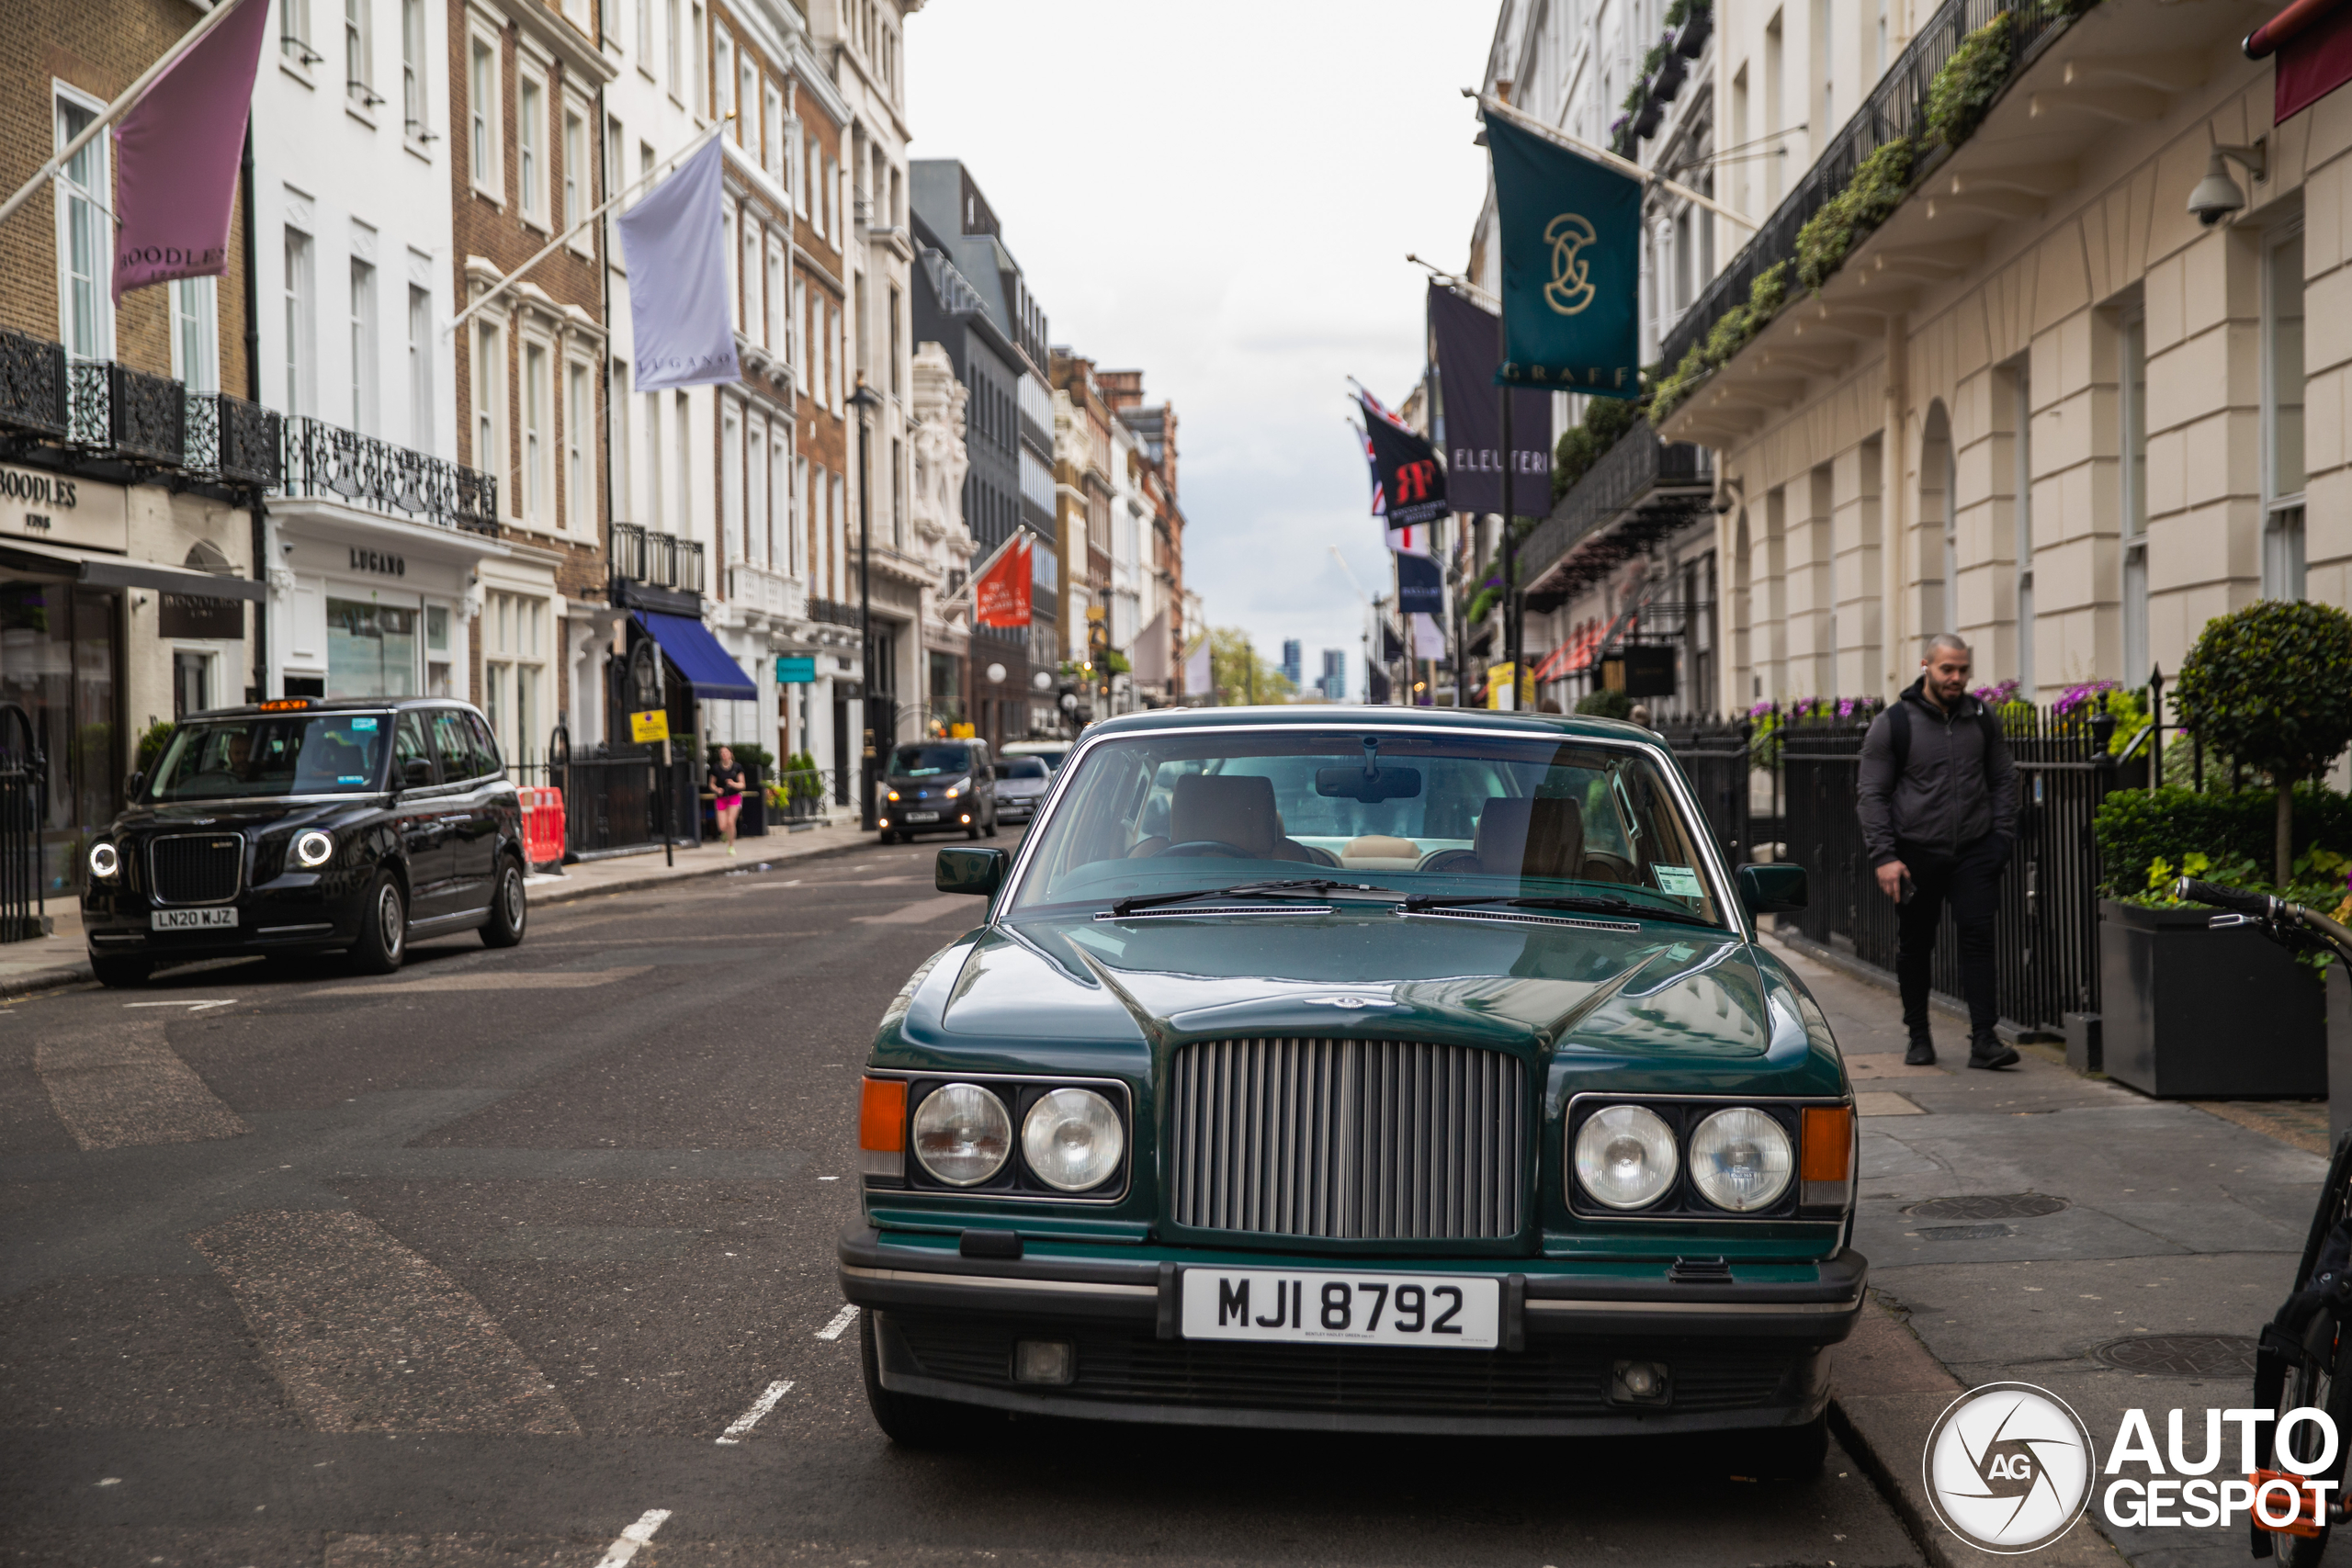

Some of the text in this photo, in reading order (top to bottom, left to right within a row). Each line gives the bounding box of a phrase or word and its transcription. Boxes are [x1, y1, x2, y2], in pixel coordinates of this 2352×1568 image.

[1503, 362, 1629, 389] GRAFF
[350, 547, 406, 578] LUGANO
[159, 909, 232, 928] LN20 WJZ
[1218, 1277, 1463, 1334] MJI 8792
